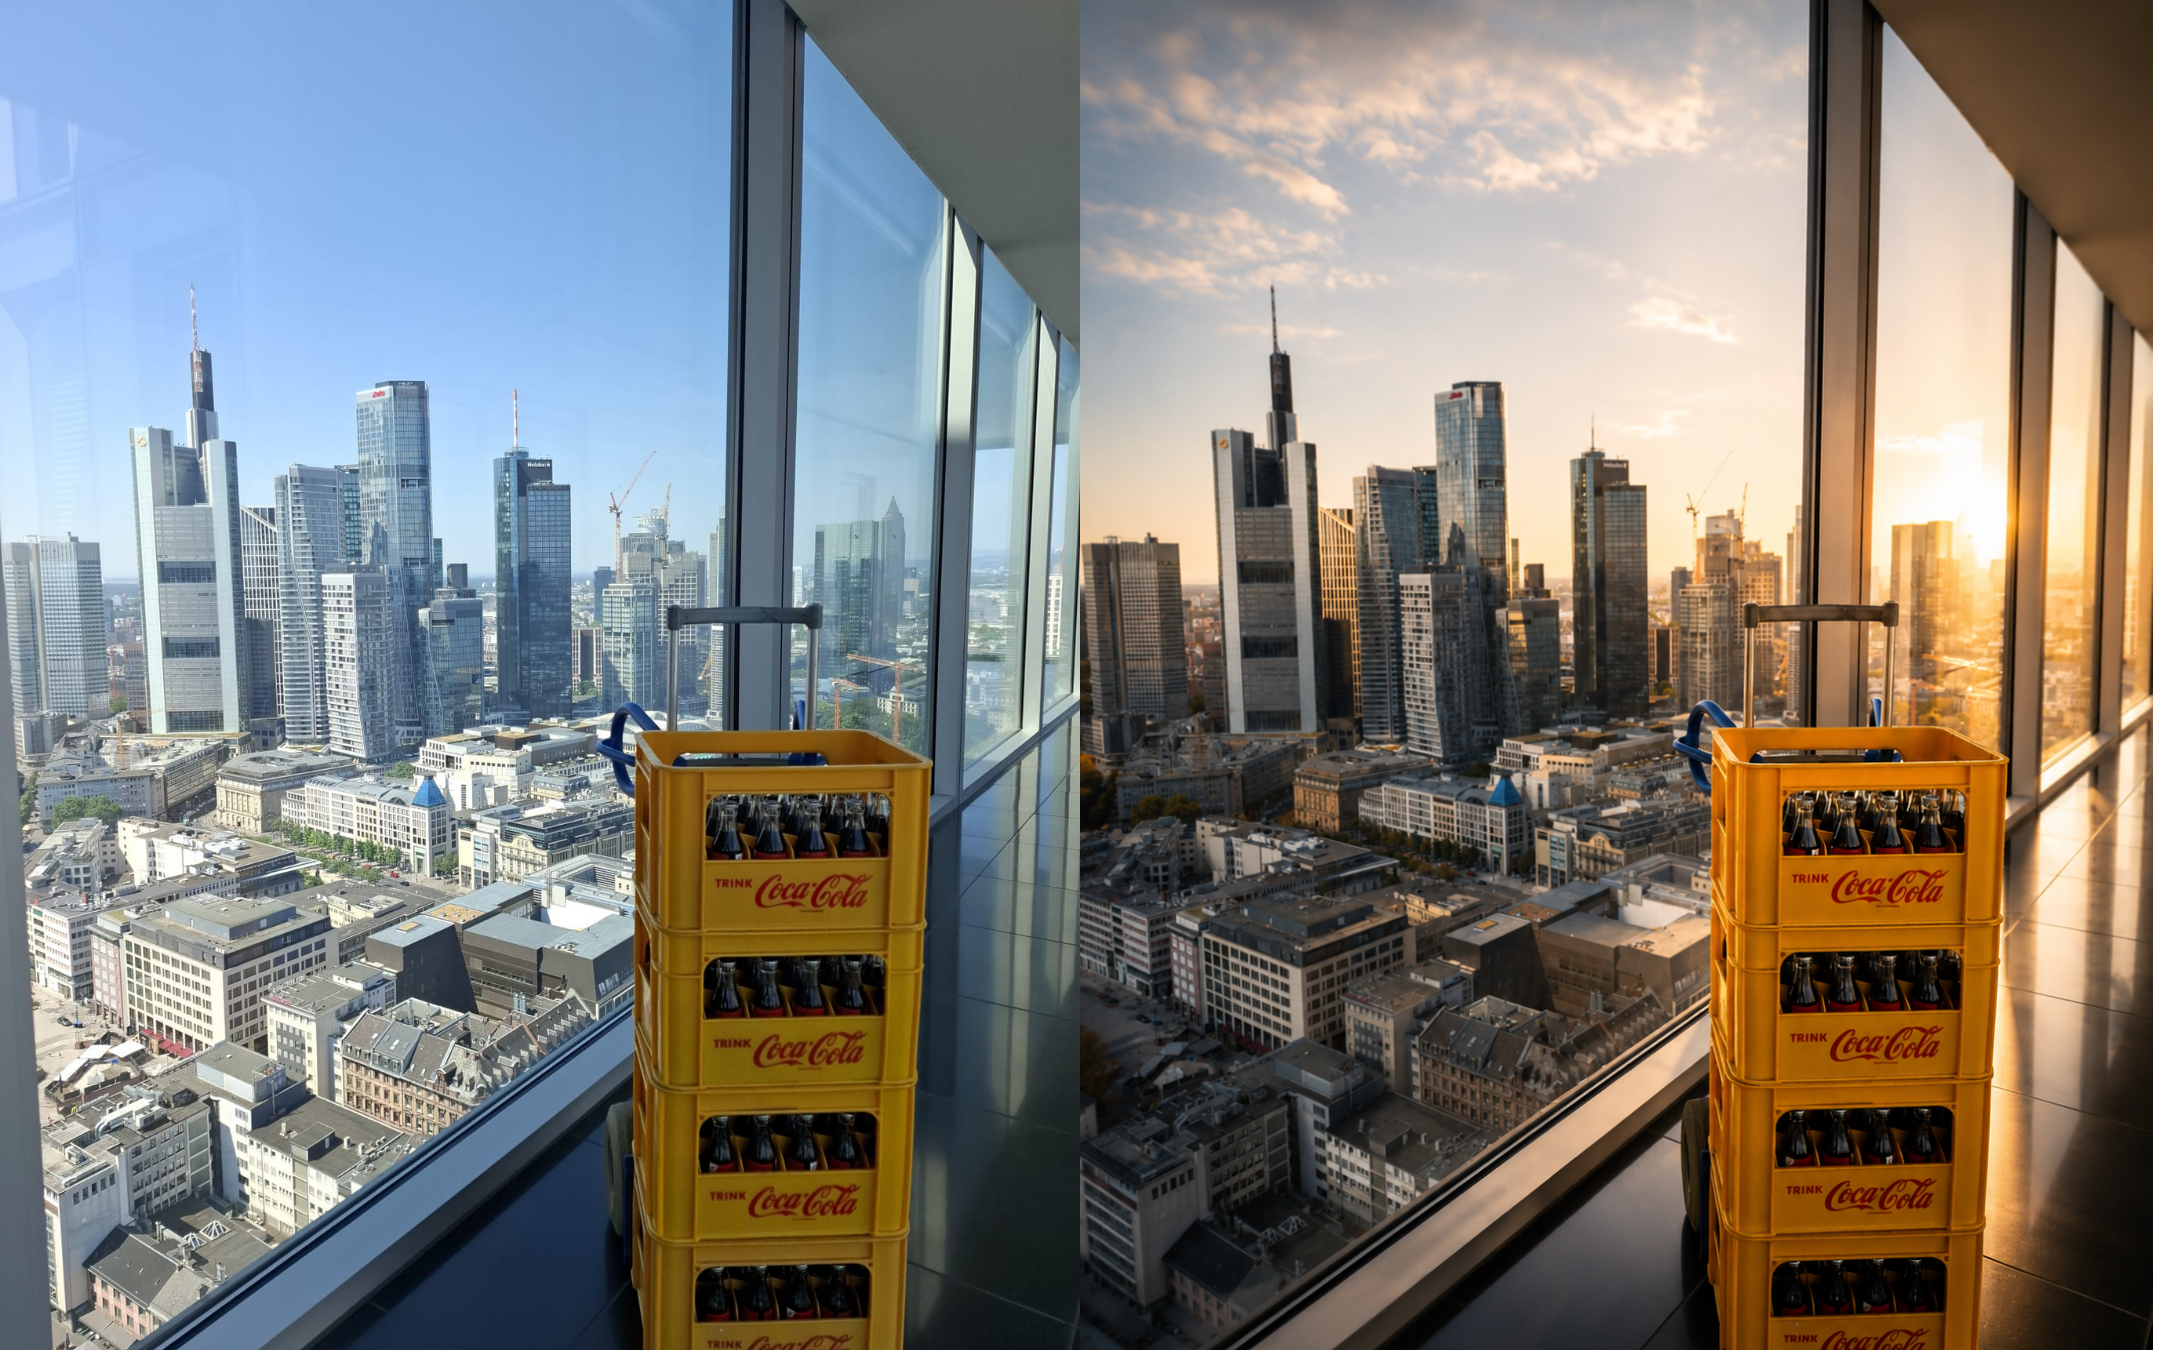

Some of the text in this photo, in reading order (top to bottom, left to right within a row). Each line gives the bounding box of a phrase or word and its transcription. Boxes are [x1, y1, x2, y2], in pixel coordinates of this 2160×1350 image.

[715, 873, 873, 909] TRINK Coca-Cola
[1791, 869, 1950, 905] TRINK Coca-Cola
[713, 1030, 868, 1069] TRINK Coca-Cola
[1790, 1025, 1944, 1063] TRINK Coca-Cola
[709, 1183, 862, 1219] TRINK Coca-Cola
[1786, 1177, 1938, 1212] TRINK Coca-Cola
[706, 1340, 743, 1349] TRINK
[1783, 1334, 1819, 1343] TRINK
